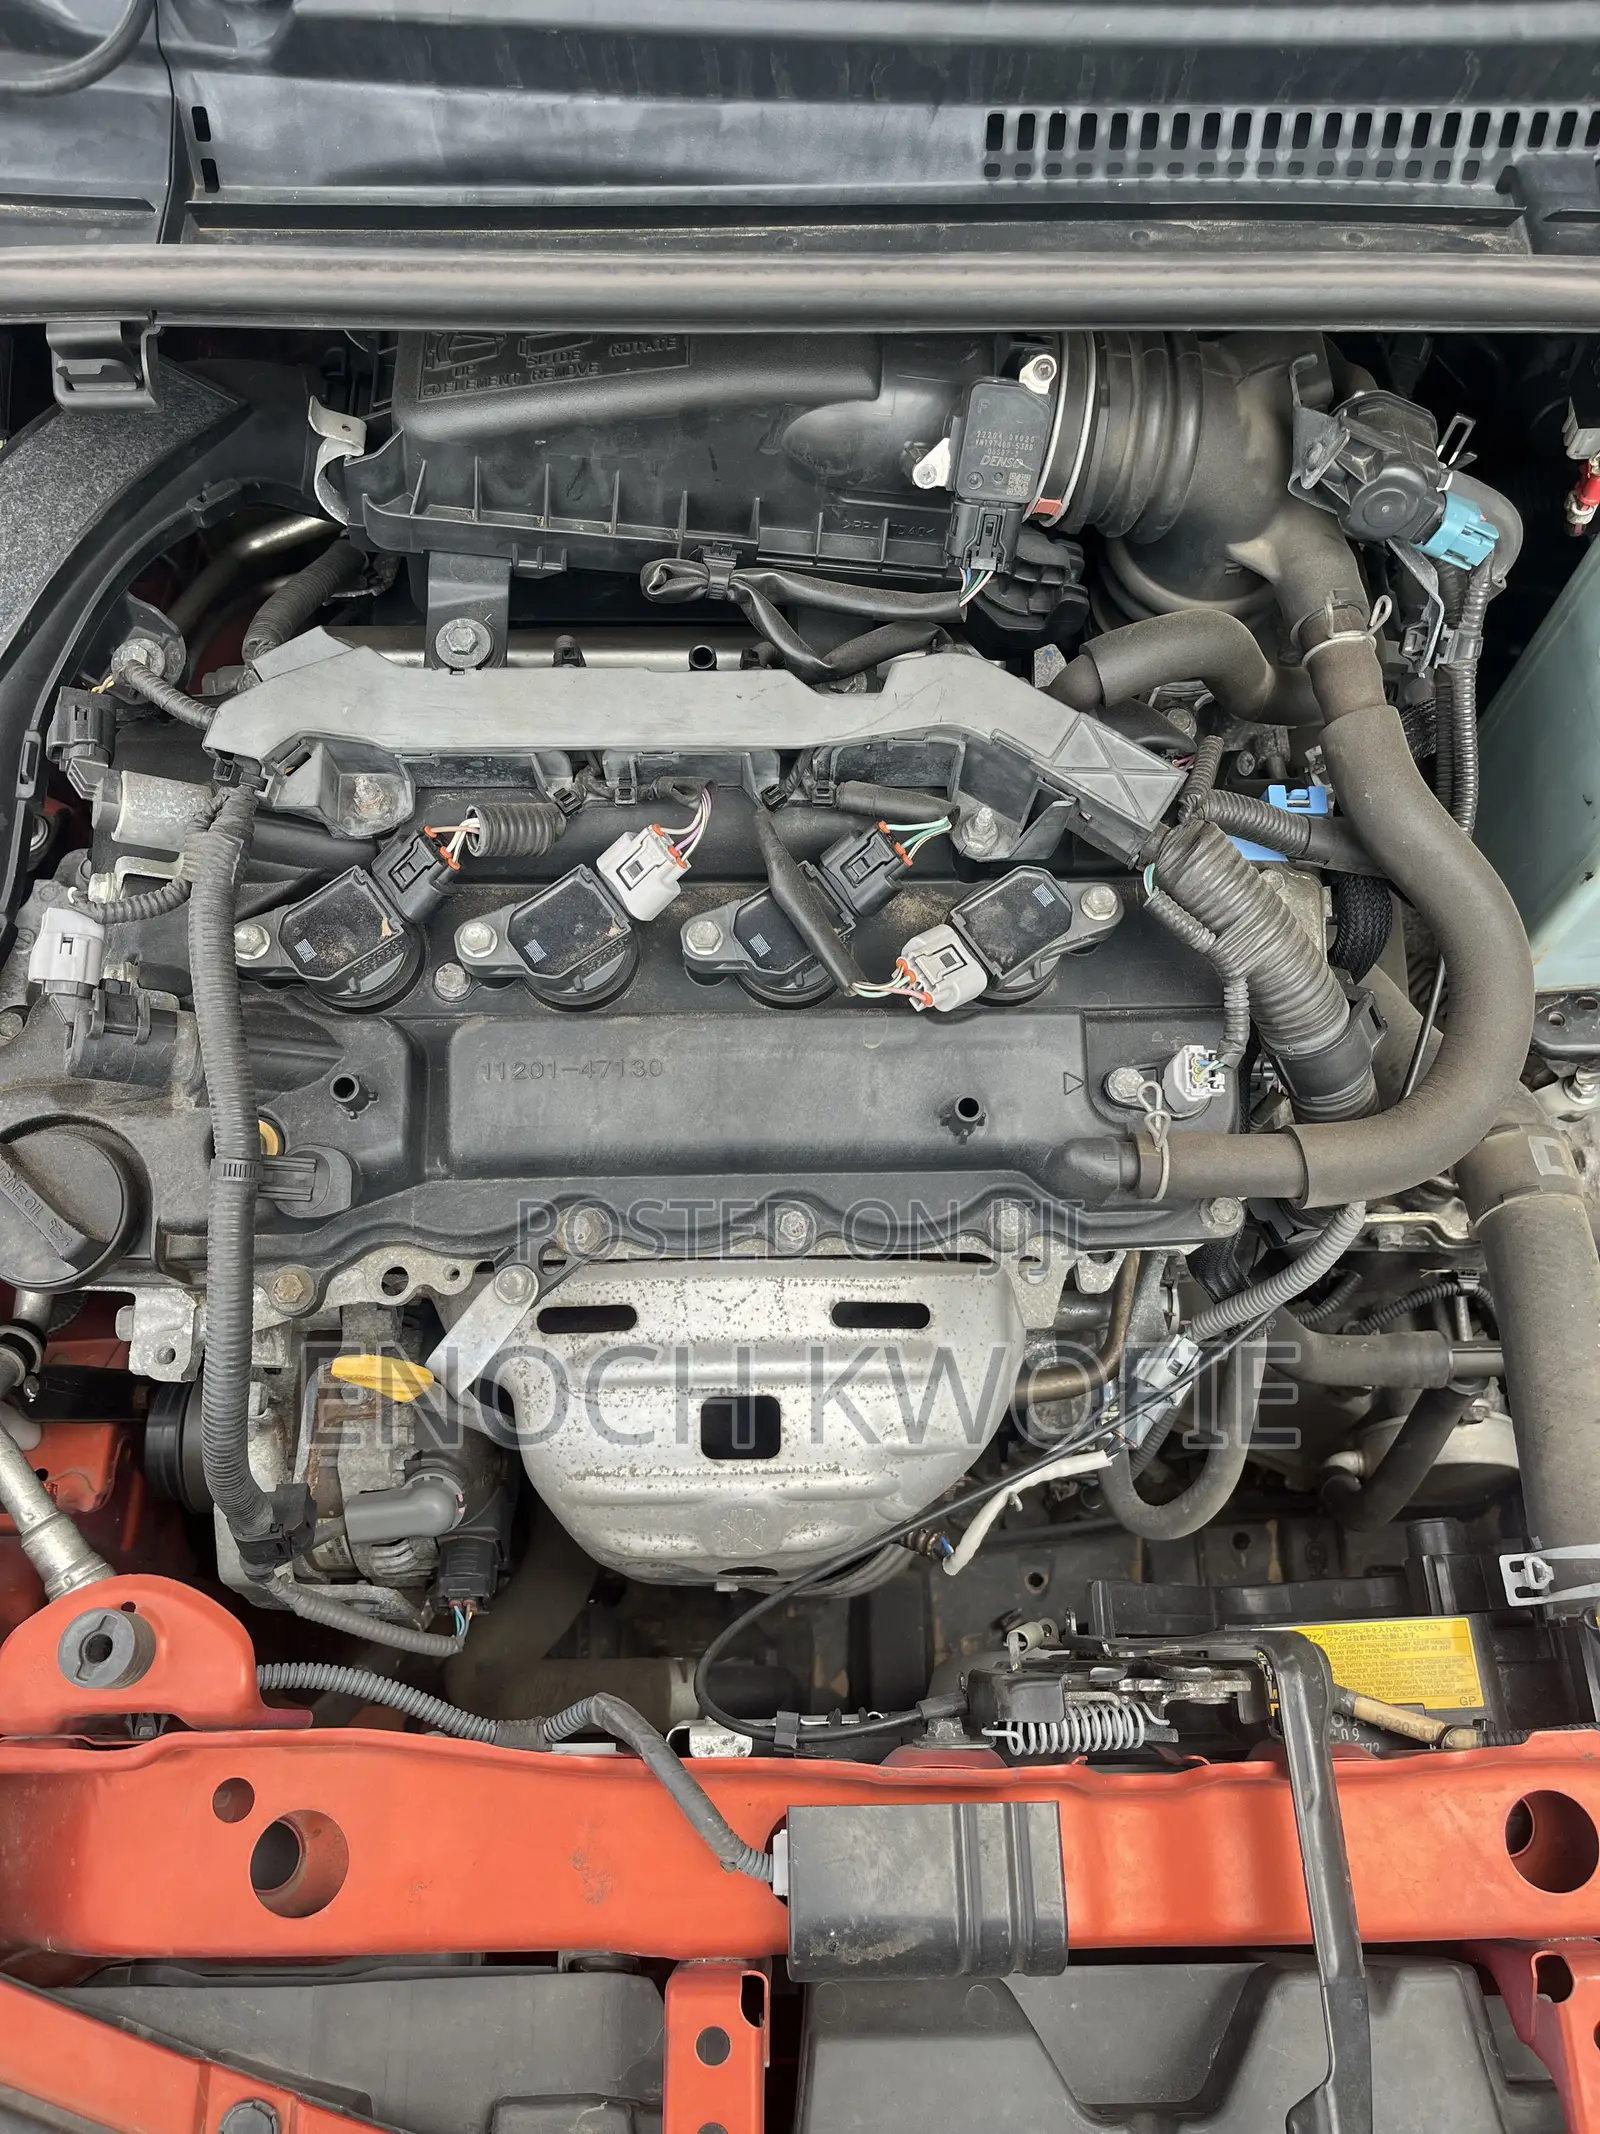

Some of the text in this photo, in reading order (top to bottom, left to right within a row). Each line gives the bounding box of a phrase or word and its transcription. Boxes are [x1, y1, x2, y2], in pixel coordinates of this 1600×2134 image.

[979, 454, 1024, 469] DENSO
[481, 1058, 664, 1081] 11201-47130
[24, 1196, 44, 1220] OIL
[1459, 1696, 1477, 1706] GP
